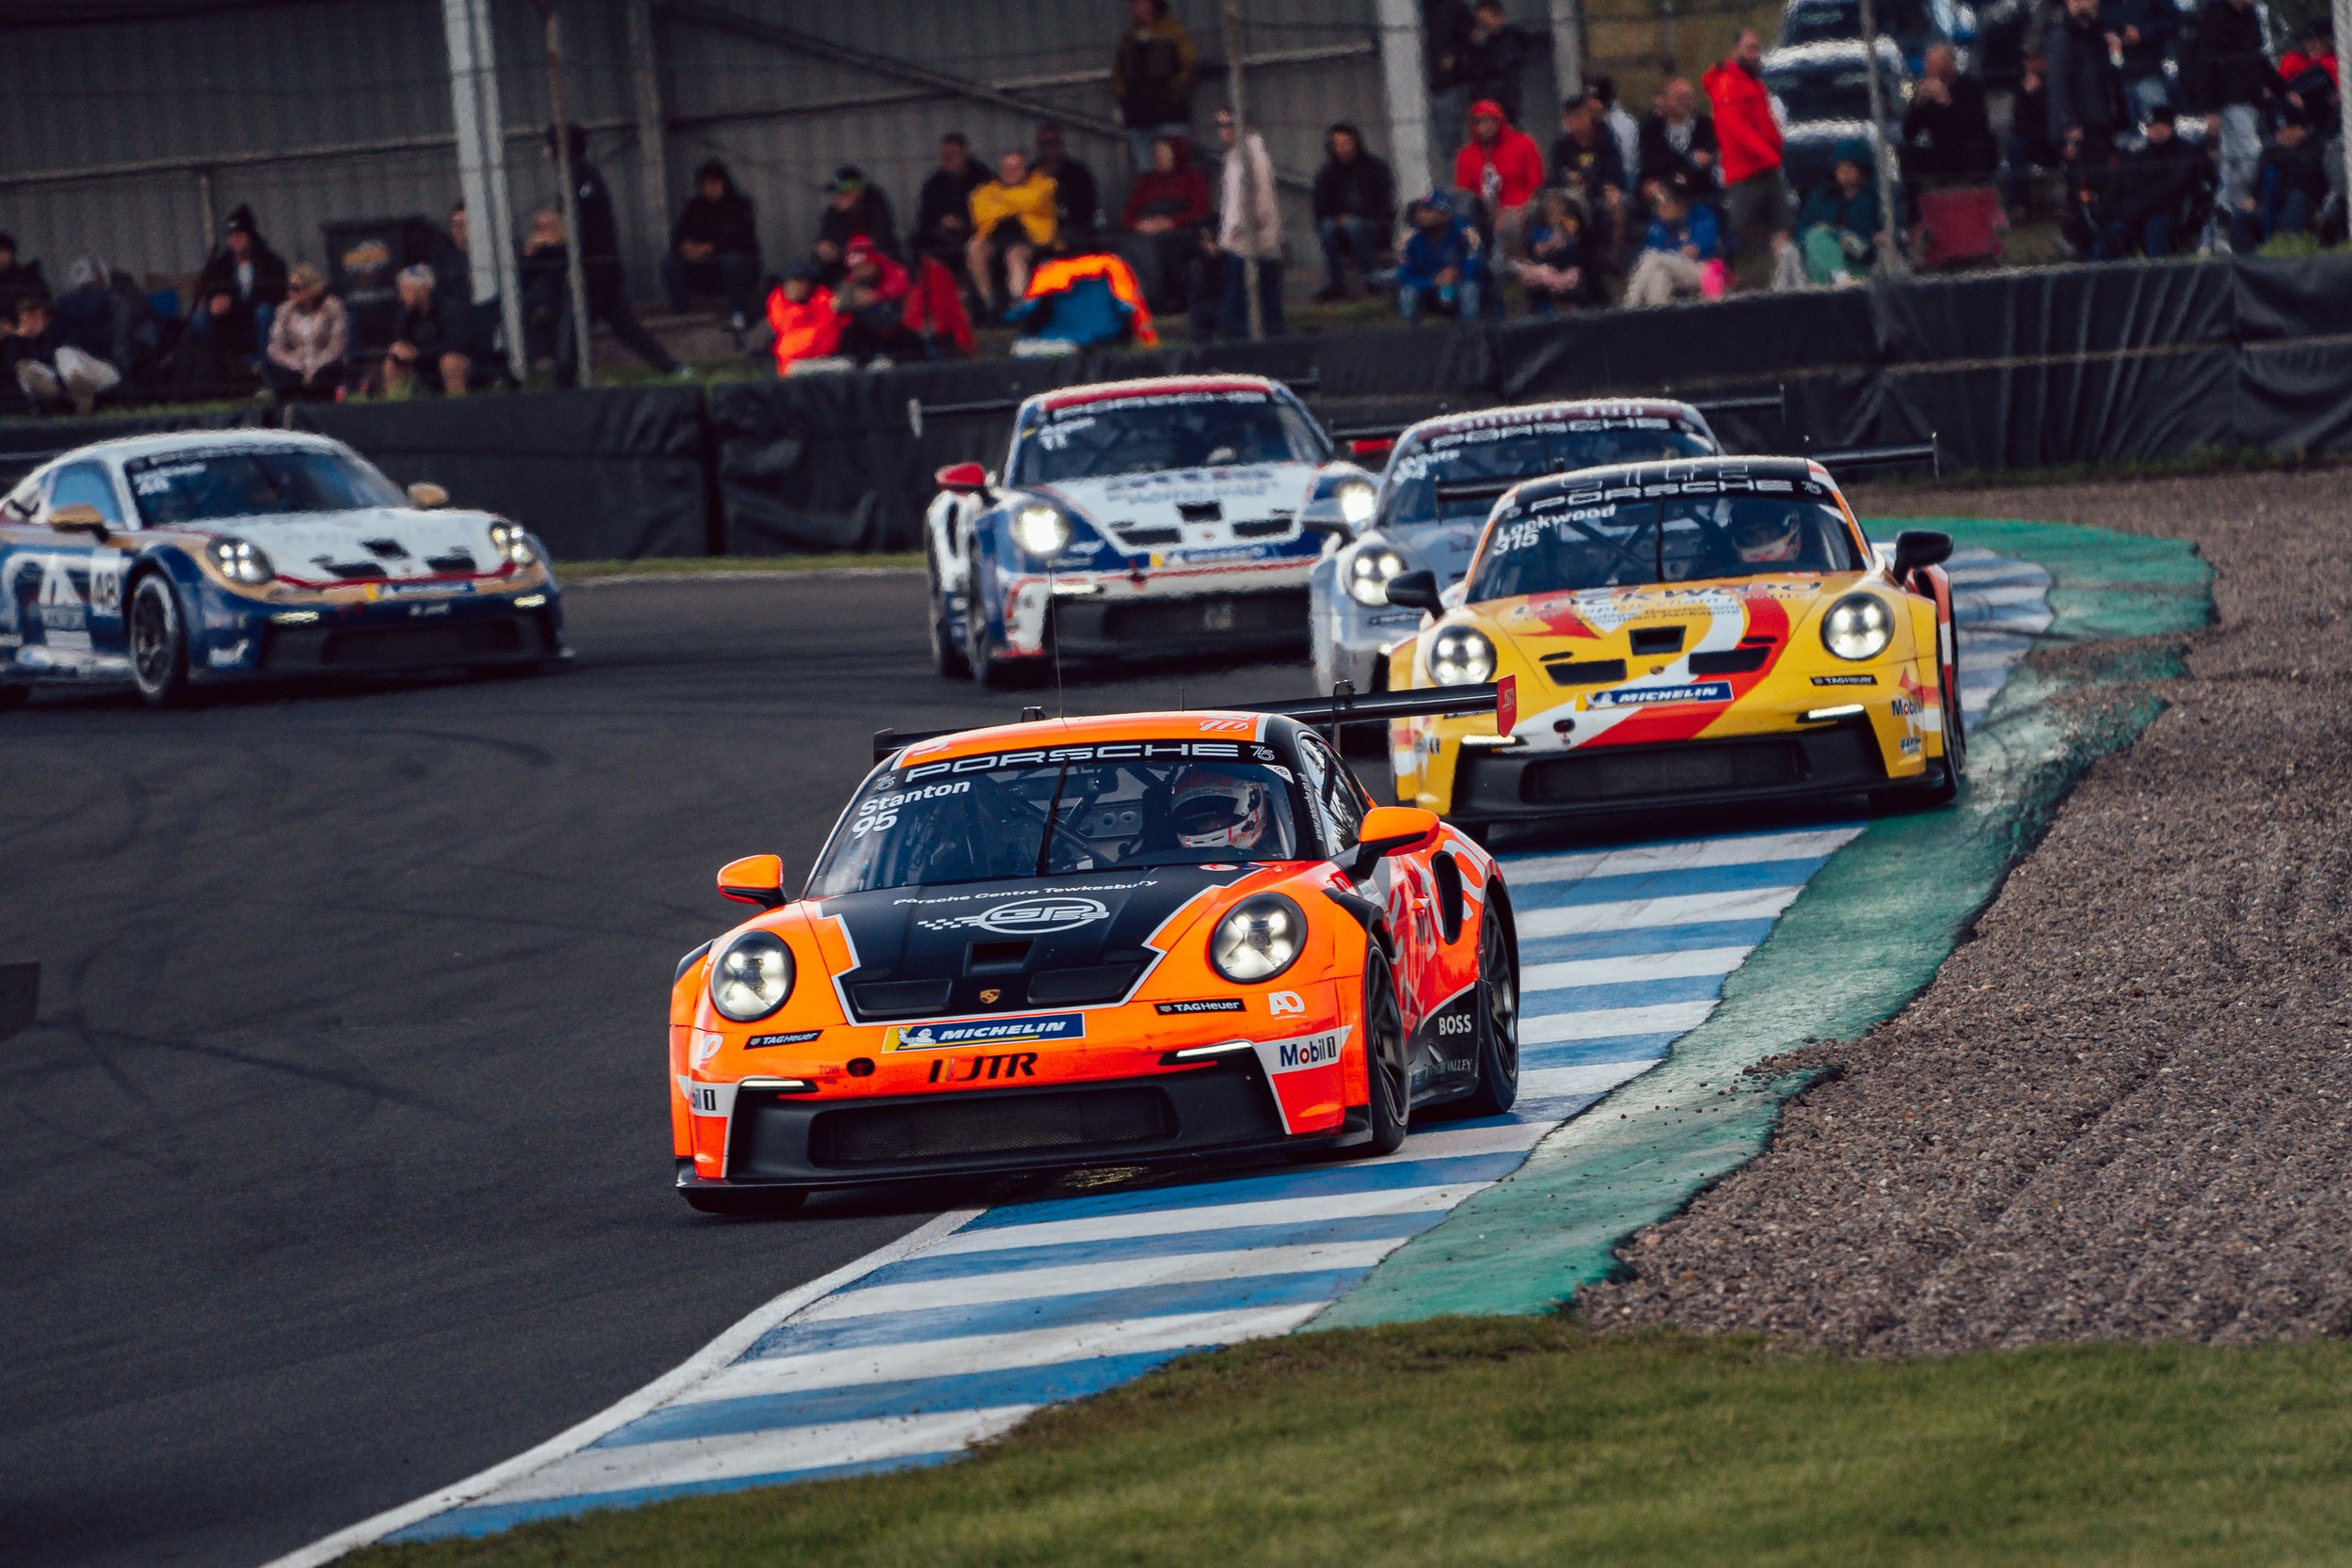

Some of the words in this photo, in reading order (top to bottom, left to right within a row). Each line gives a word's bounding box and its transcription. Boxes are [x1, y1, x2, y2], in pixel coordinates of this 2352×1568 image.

[1530, 479, 1793, 513] PORSCHE
[1497, 503, 1617, 542] Lockwood
[1491, 530, 1540, 556] 315
[1618, 687, 1719, 704] MICHELIN
[905, 743, 1239, 783] PORSCHE
[858, 781, 971, 817] Stanton
[851, 808, 900, 839] 95
[894, 894, 970, 906] Porsche
[975, 889, 1039, 900] Centre
[1043, 879, 1158, 895] Tewkesbury
[1173, 1002, 1240, 1012] TAGHeuer
[939, 1021, 1067, 1041] MICHELIN
[1438, 1014, 1472, 1035] BOSS
[762, 1033, 818, 1045] TAGHeuer
[1280, 1037, 1327, 1067] Mobil
